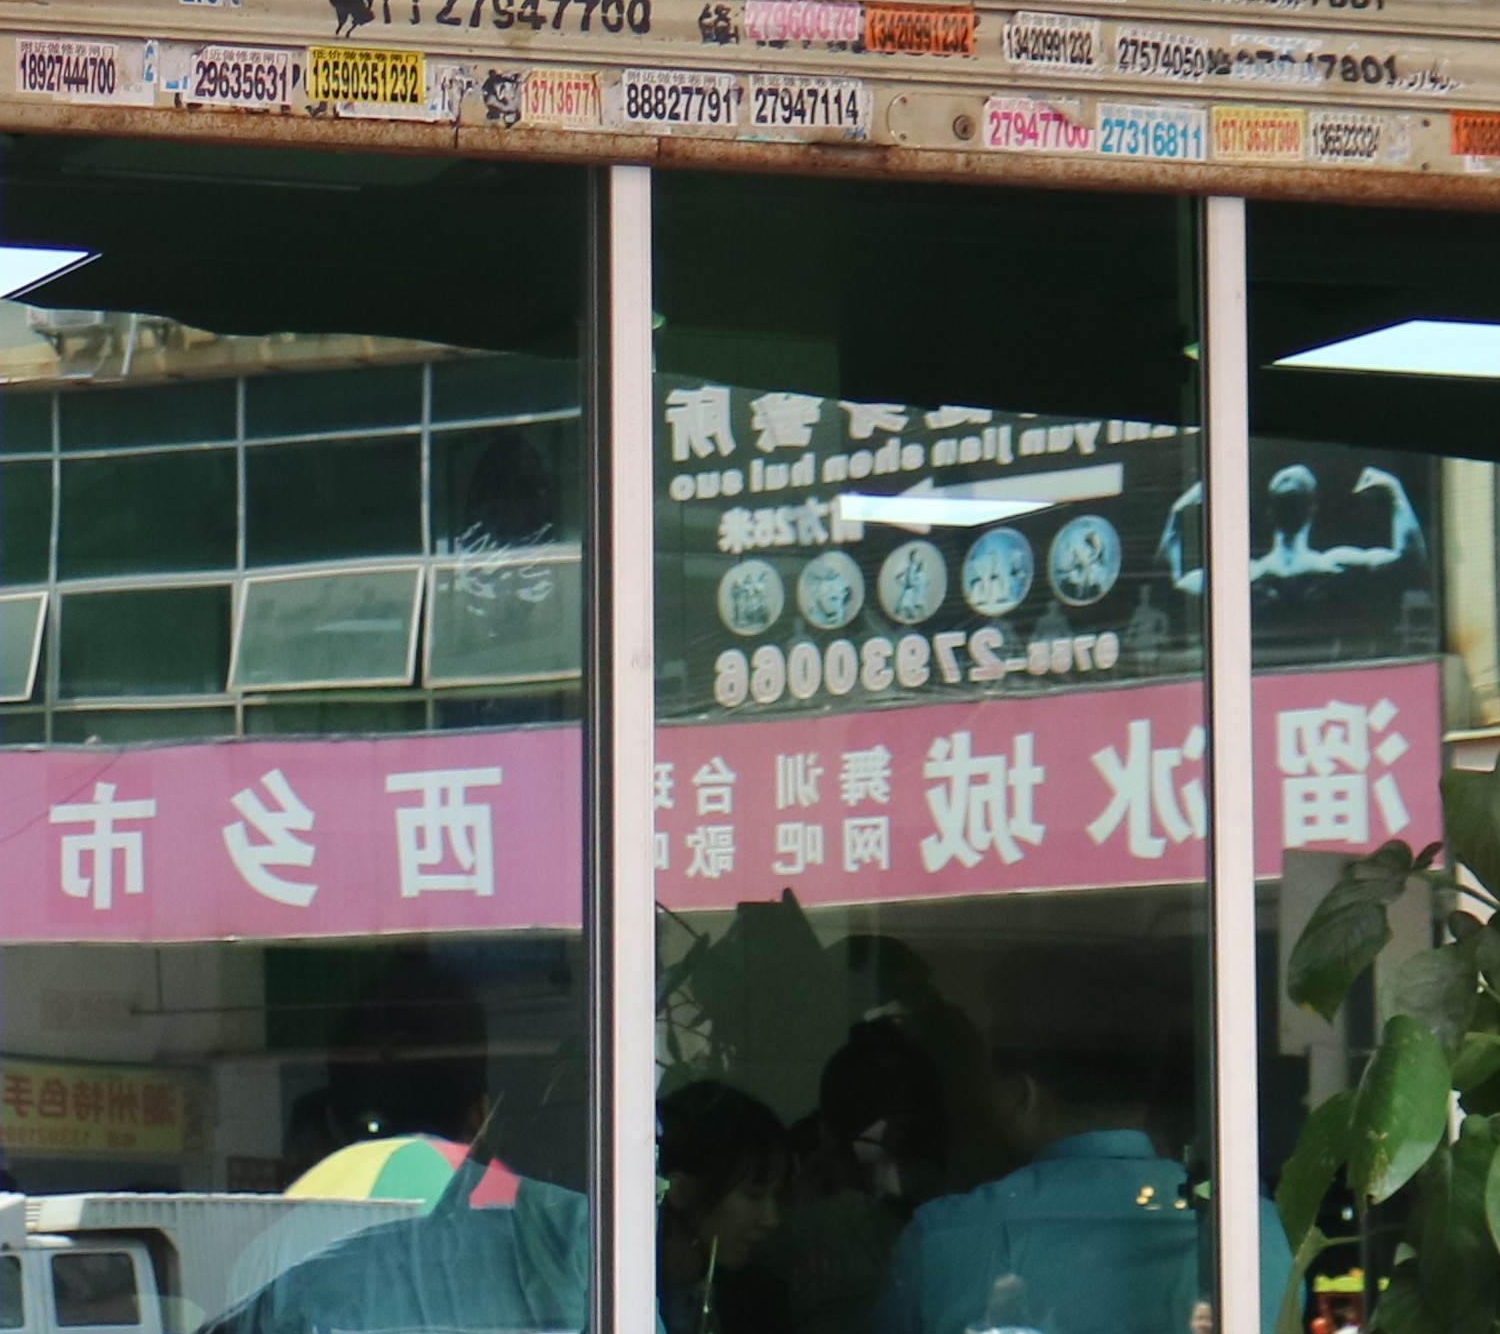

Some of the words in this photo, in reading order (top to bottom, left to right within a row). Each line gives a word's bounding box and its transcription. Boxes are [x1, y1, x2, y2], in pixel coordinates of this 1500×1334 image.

[195, 60, 288, 101] 29635631
[311, 59, 419, 104] 13590351232
[627, 86, 732, 124] 88827791
[753, 88, 860, 126] 27947114
[1100, 117, 1202, 158] 27316811
